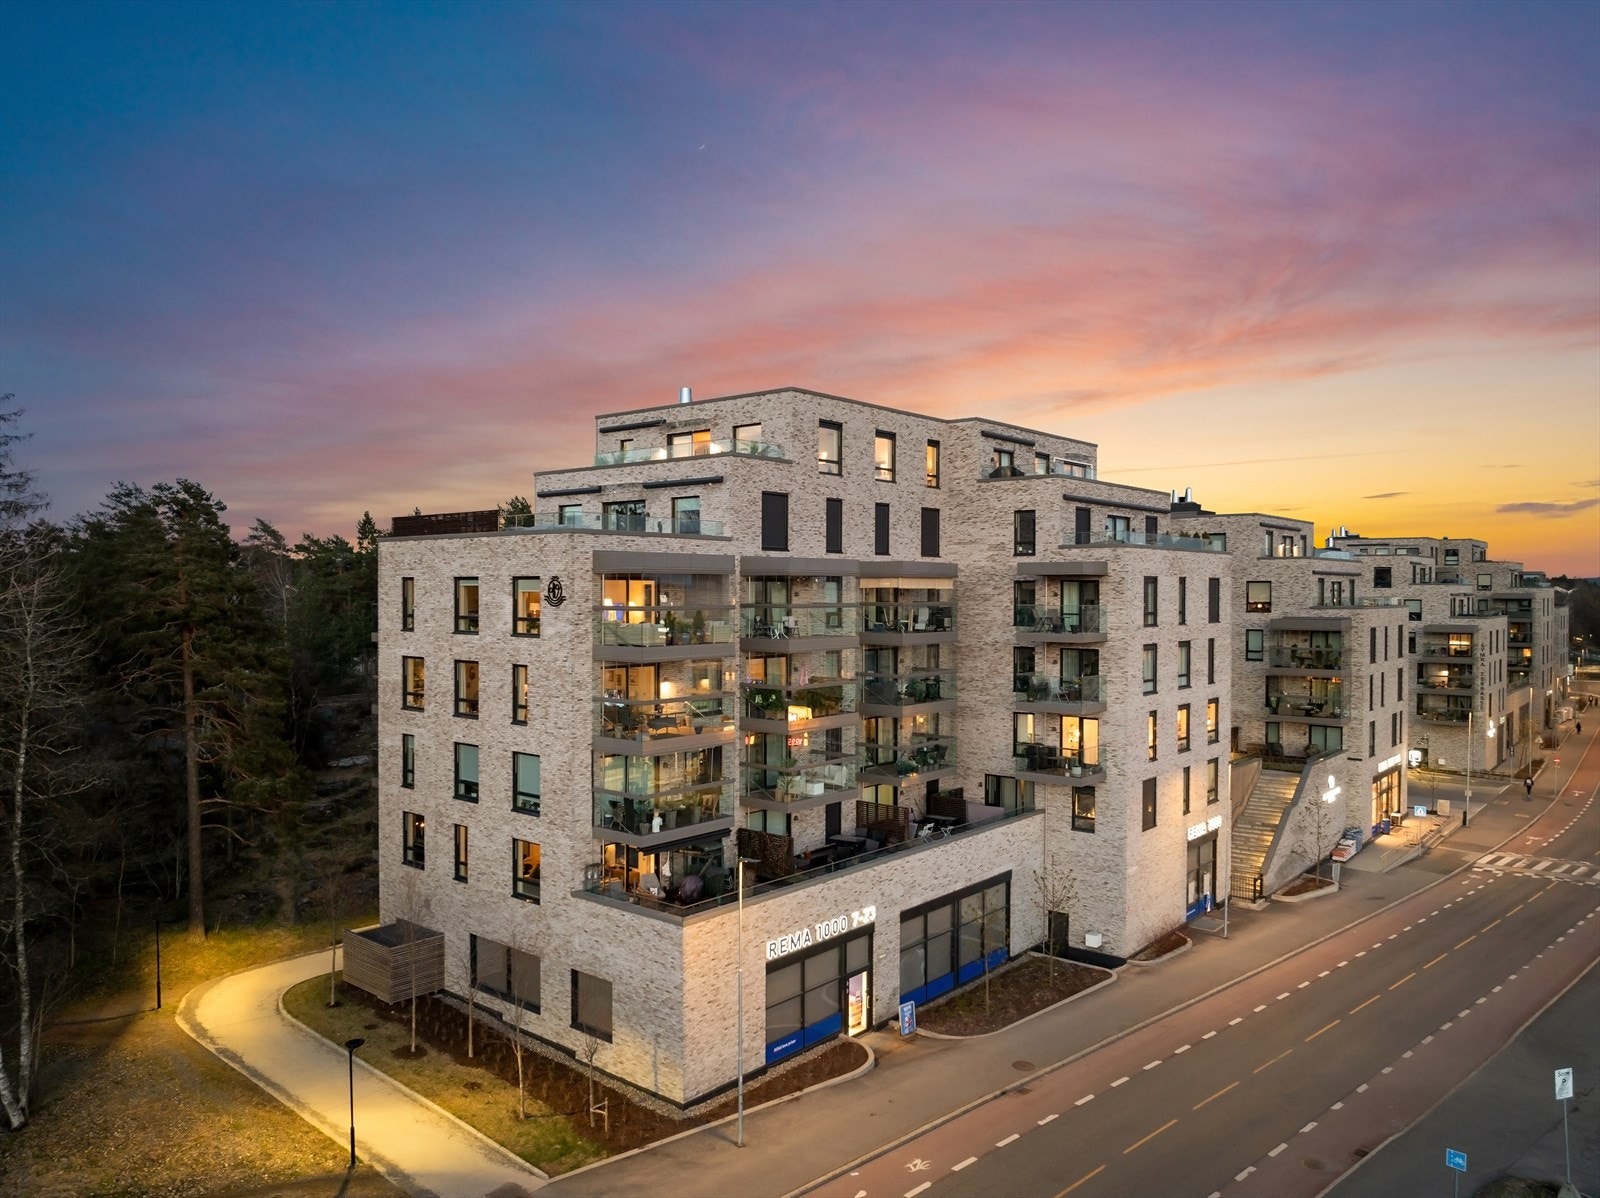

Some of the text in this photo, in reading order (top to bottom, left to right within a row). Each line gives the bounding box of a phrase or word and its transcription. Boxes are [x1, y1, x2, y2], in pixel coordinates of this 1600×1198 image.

[768, 905, 876, 959] REMA 1000 7-23
